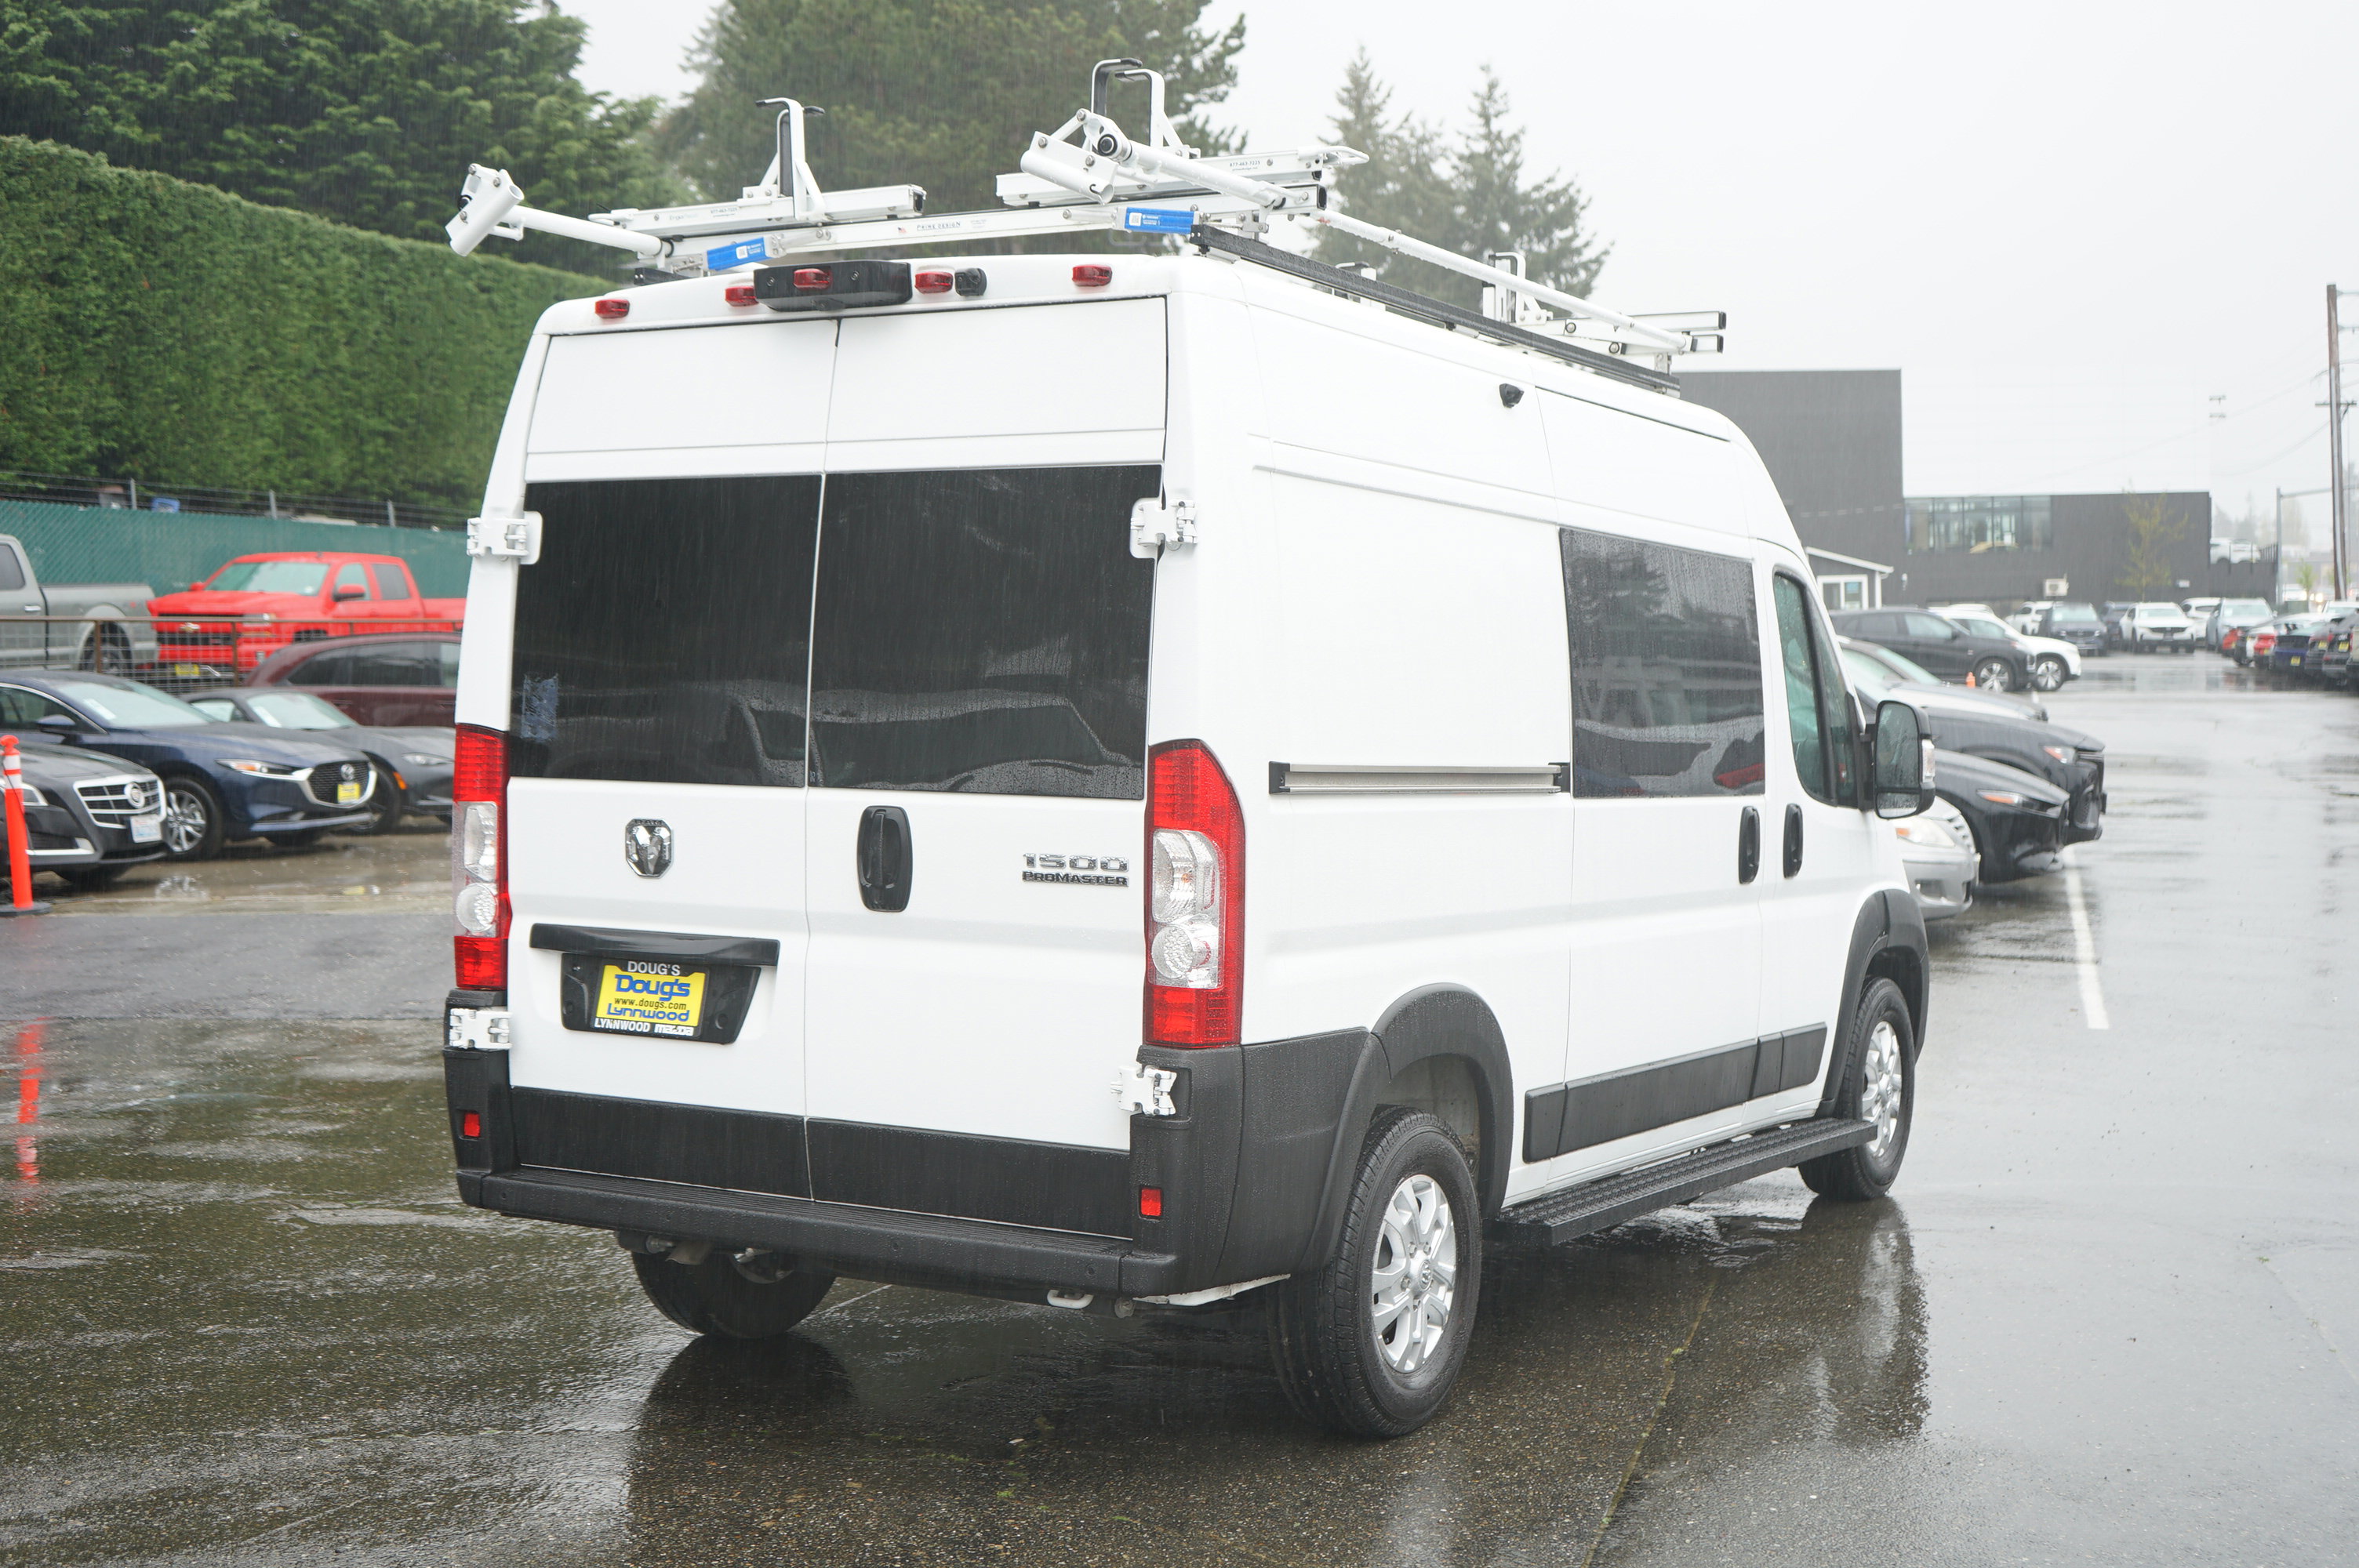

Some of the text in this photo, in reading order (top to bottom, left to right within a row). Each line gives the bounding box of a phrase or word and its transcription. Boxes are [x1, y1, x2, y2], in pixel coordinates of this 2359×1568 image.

[1023, 853, 1130, 872] 1500
[627, 960, 681, 976] DOUG'S
[615, 975, 691, 1001] Doug's
[607, 1003, 690, 1022] Lynnwood
[614, 998, 687, 1010] www.dougs.com
[594, 1018, 650, 1033] LYNNWOOD
